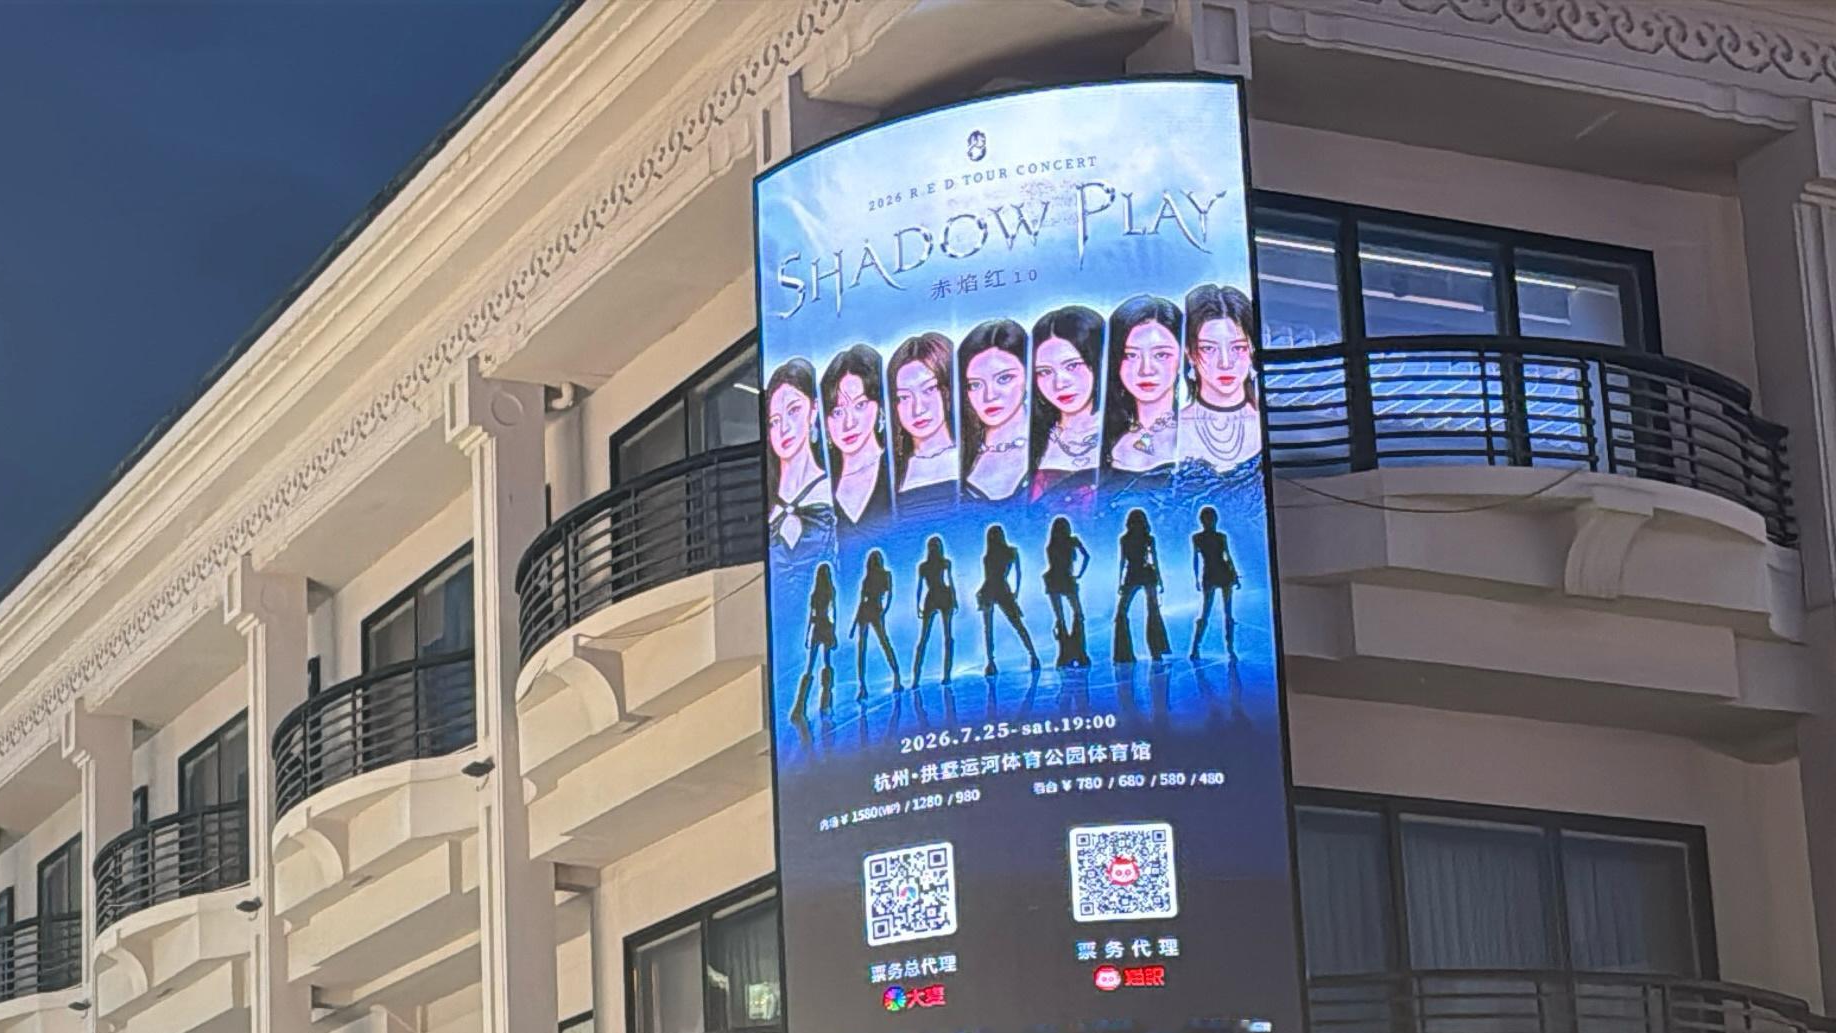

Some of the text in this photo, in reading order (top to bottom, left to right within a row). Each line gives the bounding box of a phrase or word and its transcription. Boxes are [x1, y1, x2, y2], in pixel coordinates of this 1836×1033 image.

[868, 192, 902, 212] 2026
[961, 168, 1008, 186] TOUR
[1016, 155, 1098, 176] CONCERT
[774, 181, 1228, 320] SHADOW PLAY
[868, 954, 958, 984] 票务总代理
[1075, 937, 1181, 961] 票务代理
